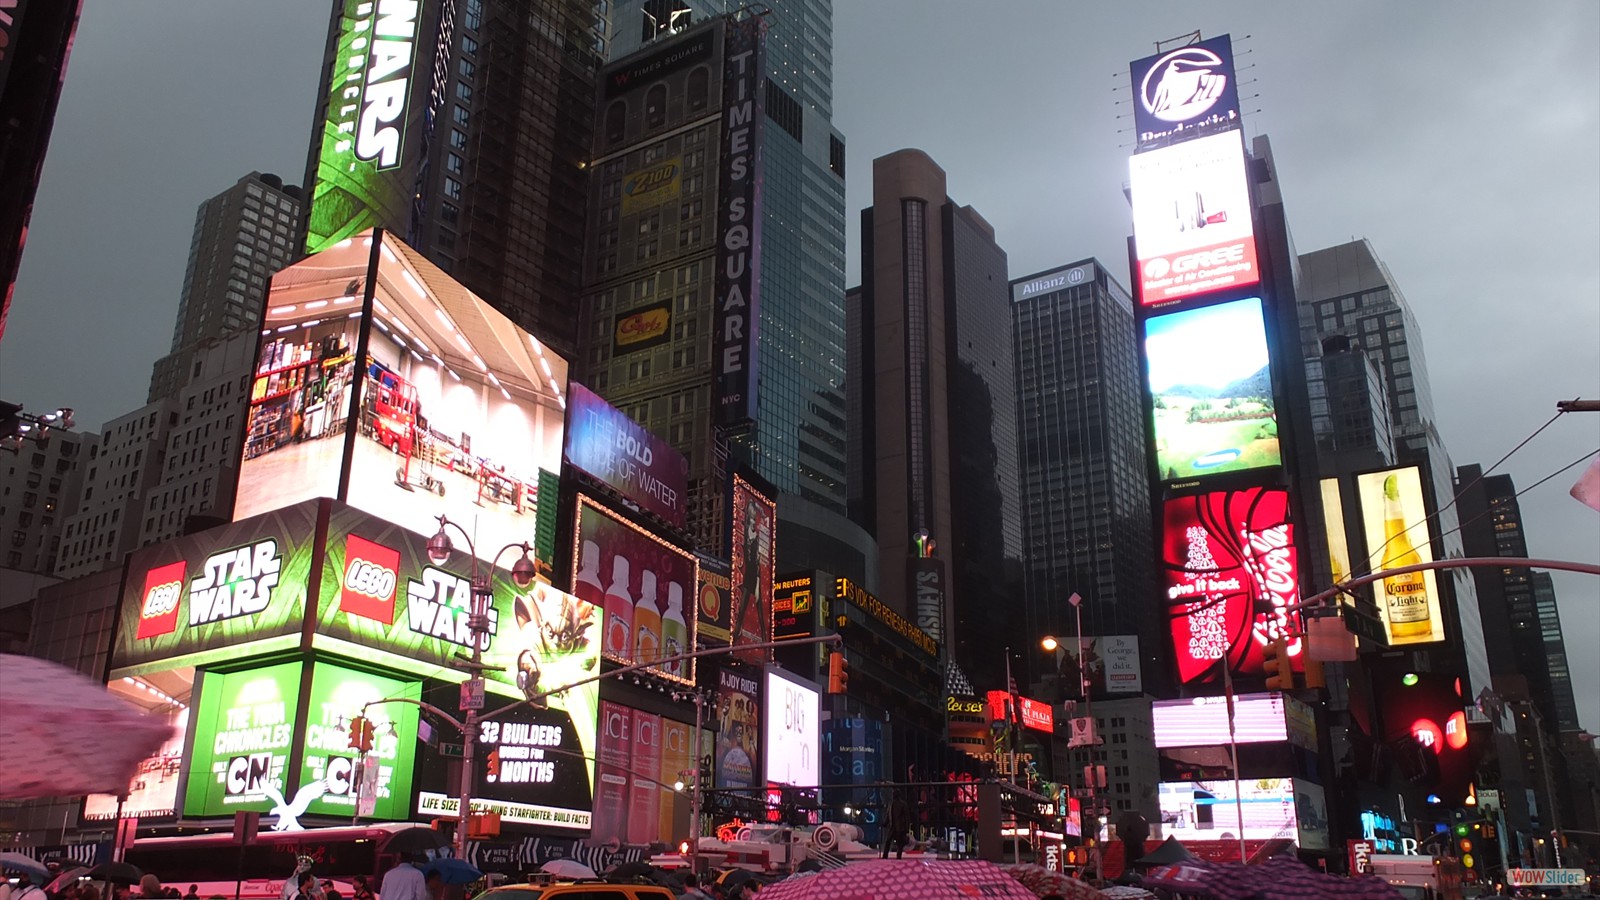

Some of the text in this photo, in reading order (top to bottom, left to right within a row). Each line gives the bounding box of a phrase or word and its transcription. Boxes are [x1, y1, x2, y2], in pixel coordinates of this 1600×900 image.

[634, 62, 661, 78] TIMES
[665, 44, 704, 65] SQUARE
[334, 0, 372, 153] HRONICLES
[630, 165, 674, 197] Z100
[723, 50, 753, 374] TIMES SQUARE
[1171, 243, 1245, 273] GREE
[1022, 276, 1066, 296] Allianz
[722, 394, 741, 405] NYC
[586, 408, 653, 467] THE BOLD
[618, 458, 636, 481] OF
[638, 468, 678, 511] WATER
[191, 540, 282, 592] STAR
[344, 558, 396, 601] LEGO
[699, 569, 730, 591] venue
[782, 578, 811, 589] REUTERS
[1168, 578, 1240, 599] give it back
[1387, 582, 1423, 596] Corona
[143, 581, 181, 618] LEGO
[189, 573, 279, 627] WARS
[700, 583, 720, 622] Q
[869, 596, 881, 618] FOR
[1396, 595, 1418, 607] Light
[1112, 662, 1124, 670] did
[726, 674, 740, 690] JOY
[227, 706, 252, 731] THE
[785, 687, 805, 734] BIG
[214, 724, 291, 755] CHRONICLES
[479, 721, 563, 747] 32 BUILDERS
[604, 710, 629, 741] ICE
[635, 718, 659, 748] ICE
[665, 726, 685, 753] ICE
[500, 761, 555, 783] MONTHS
[422, 797, 439, 810] LIFE
[440, 798, 458, 811] SIZE
[509, 806, 553, 821] STARFIGHTER:
[554, 811, 571, 823] BUILD
[571, 814, 589, 825] FACTS
[492, 856, 507, 864] OPEN
[493, 849, 509, 857] WE'RE
[1046, 845, 1058, 872] tkts
[1353, 842, 1371, 874] tkts
